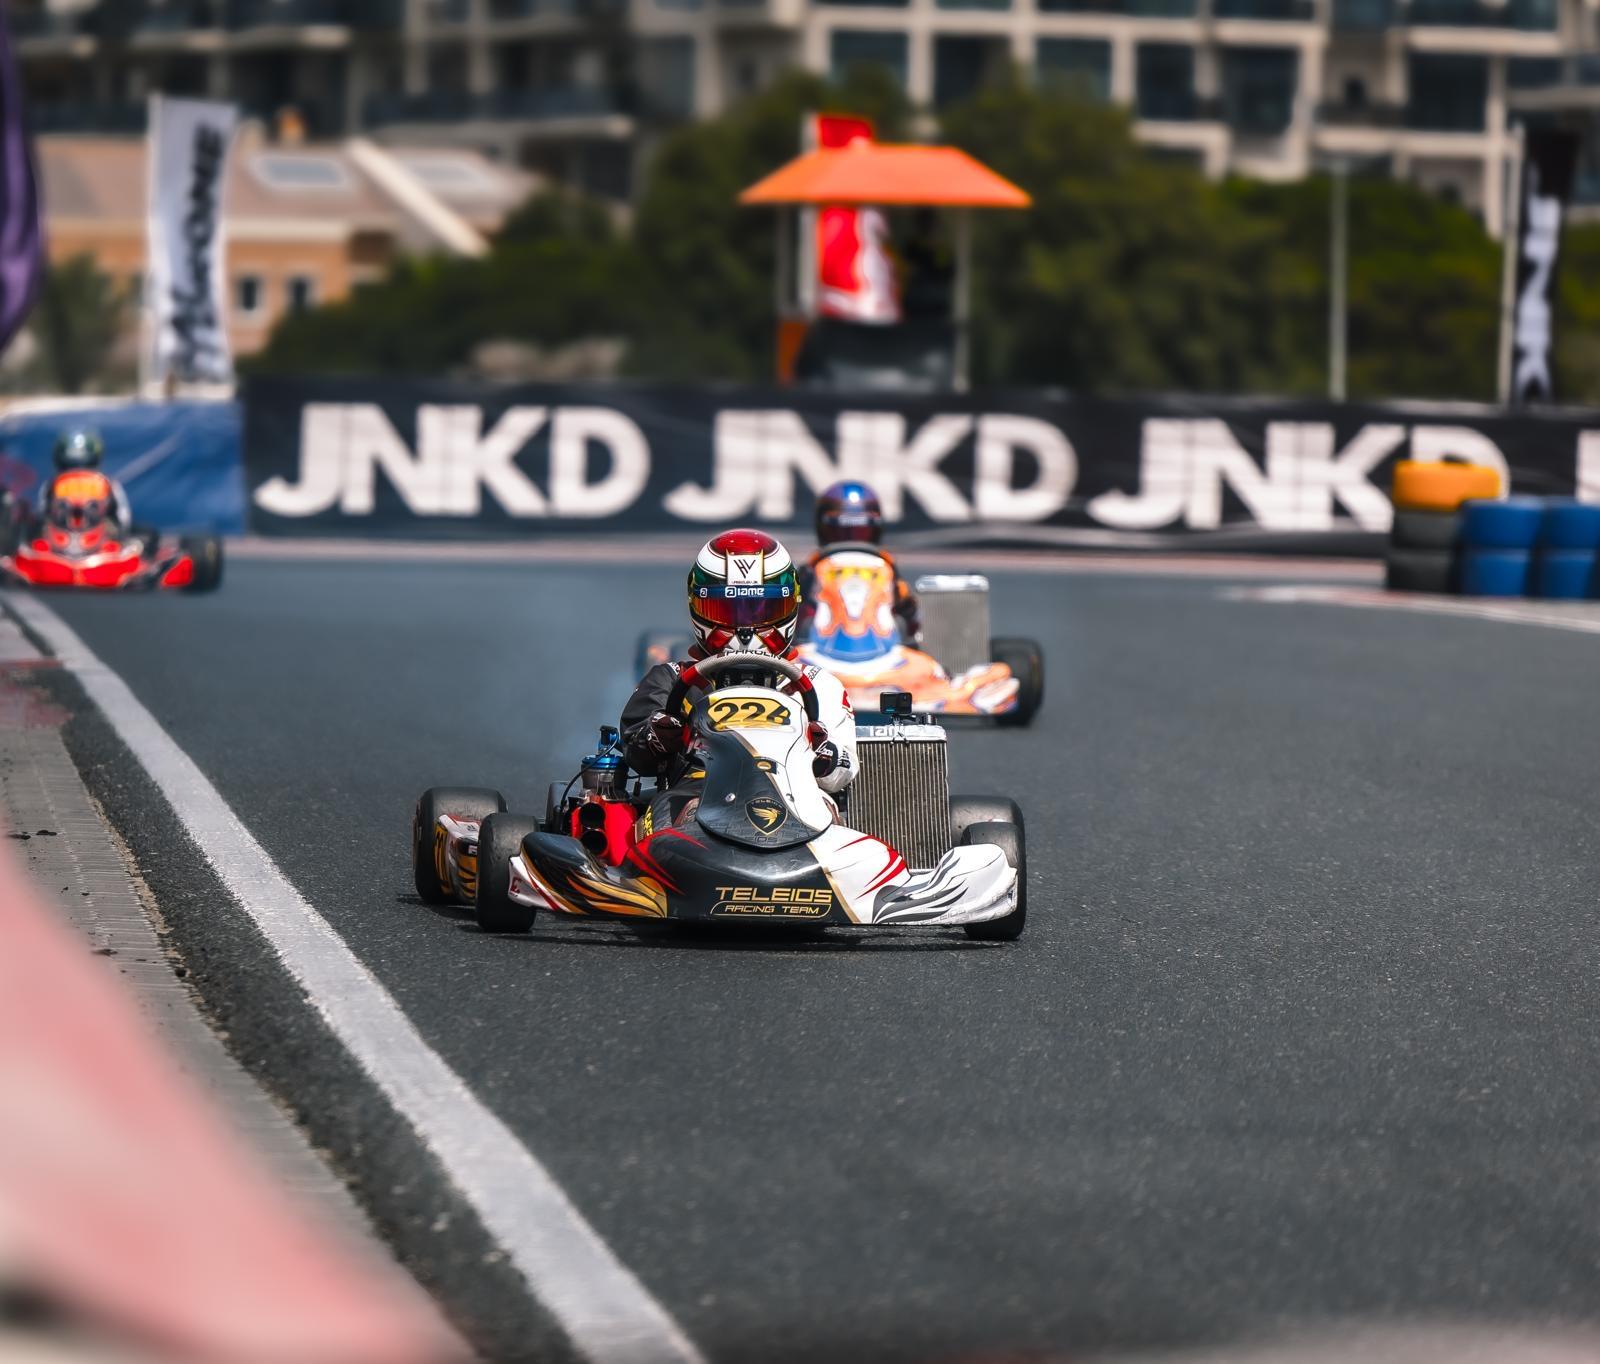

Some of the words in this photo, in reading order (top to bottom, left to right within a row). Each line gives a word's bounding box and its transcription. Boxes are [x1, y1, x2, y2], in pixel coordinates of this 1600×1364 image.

[253, 402, 651, 517] JNKD
[663, 409, 1079, 523] JNKD
[715, 887, 833, 903] TELEIOS
[725, 905, 775, 913] RACING
[781, 906, 820, 914] TEAM
